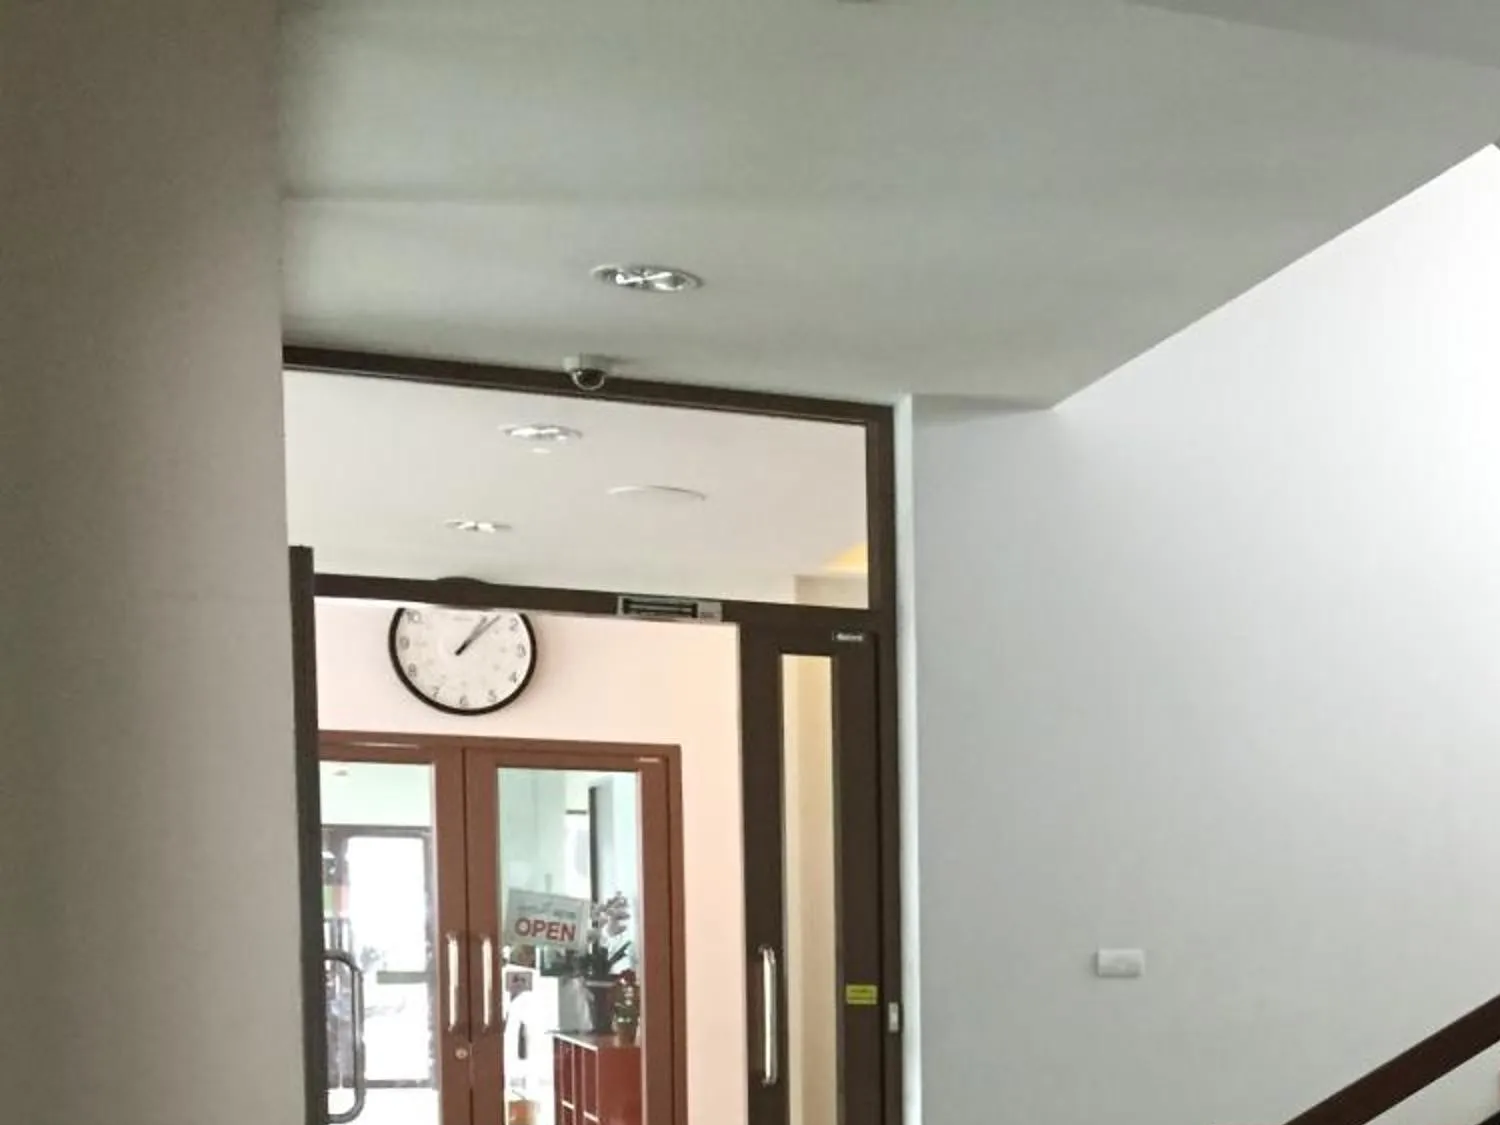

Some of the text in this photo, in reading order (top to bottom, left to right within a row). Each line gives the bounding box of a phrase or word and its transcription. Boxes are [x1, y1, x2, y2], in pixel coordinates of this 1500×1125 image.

[509, 617, 520, 632] 2
[508, 671, 518, 684] 4
[515, 917, 577, 941] OPEN
